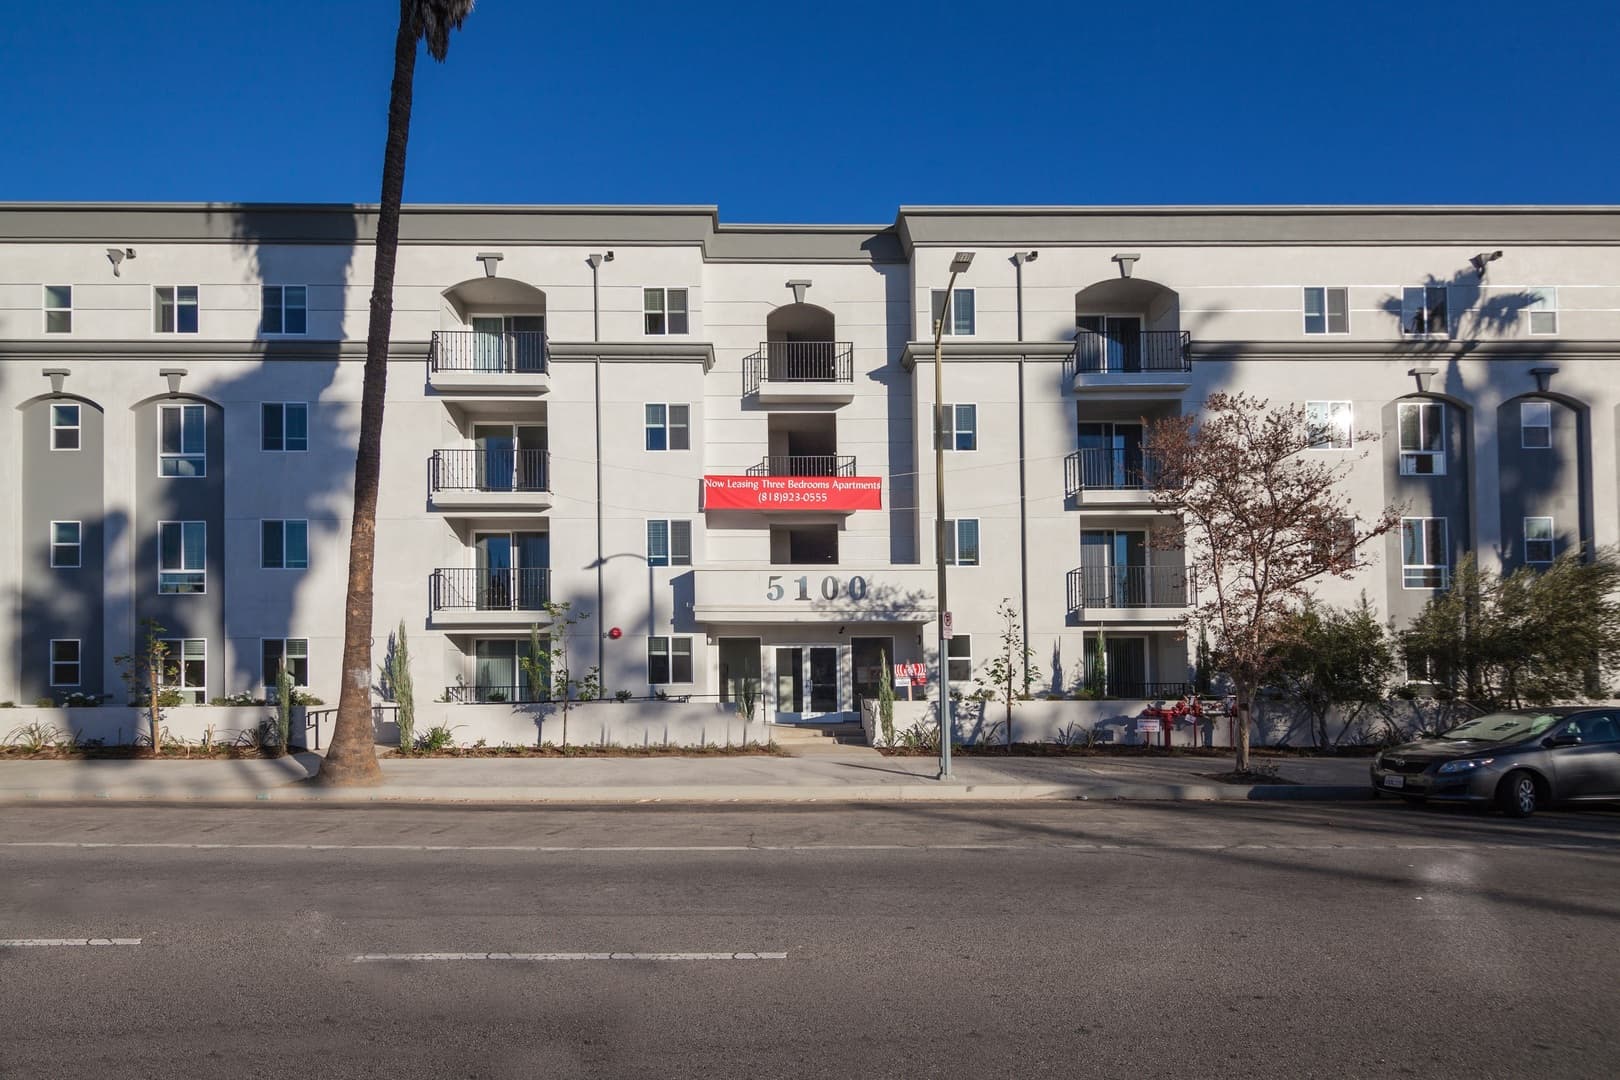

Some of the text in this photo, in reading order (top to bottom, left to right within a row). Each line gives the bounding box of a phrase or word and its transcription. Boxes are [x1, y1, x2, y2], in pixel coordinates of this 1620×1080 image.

[704, 479, 881, 491] Now Leasing Three Bedrooms Apartments
[758, 492, 828, 504] (818)923-0555
[766, 575, 867, 601] 5100
